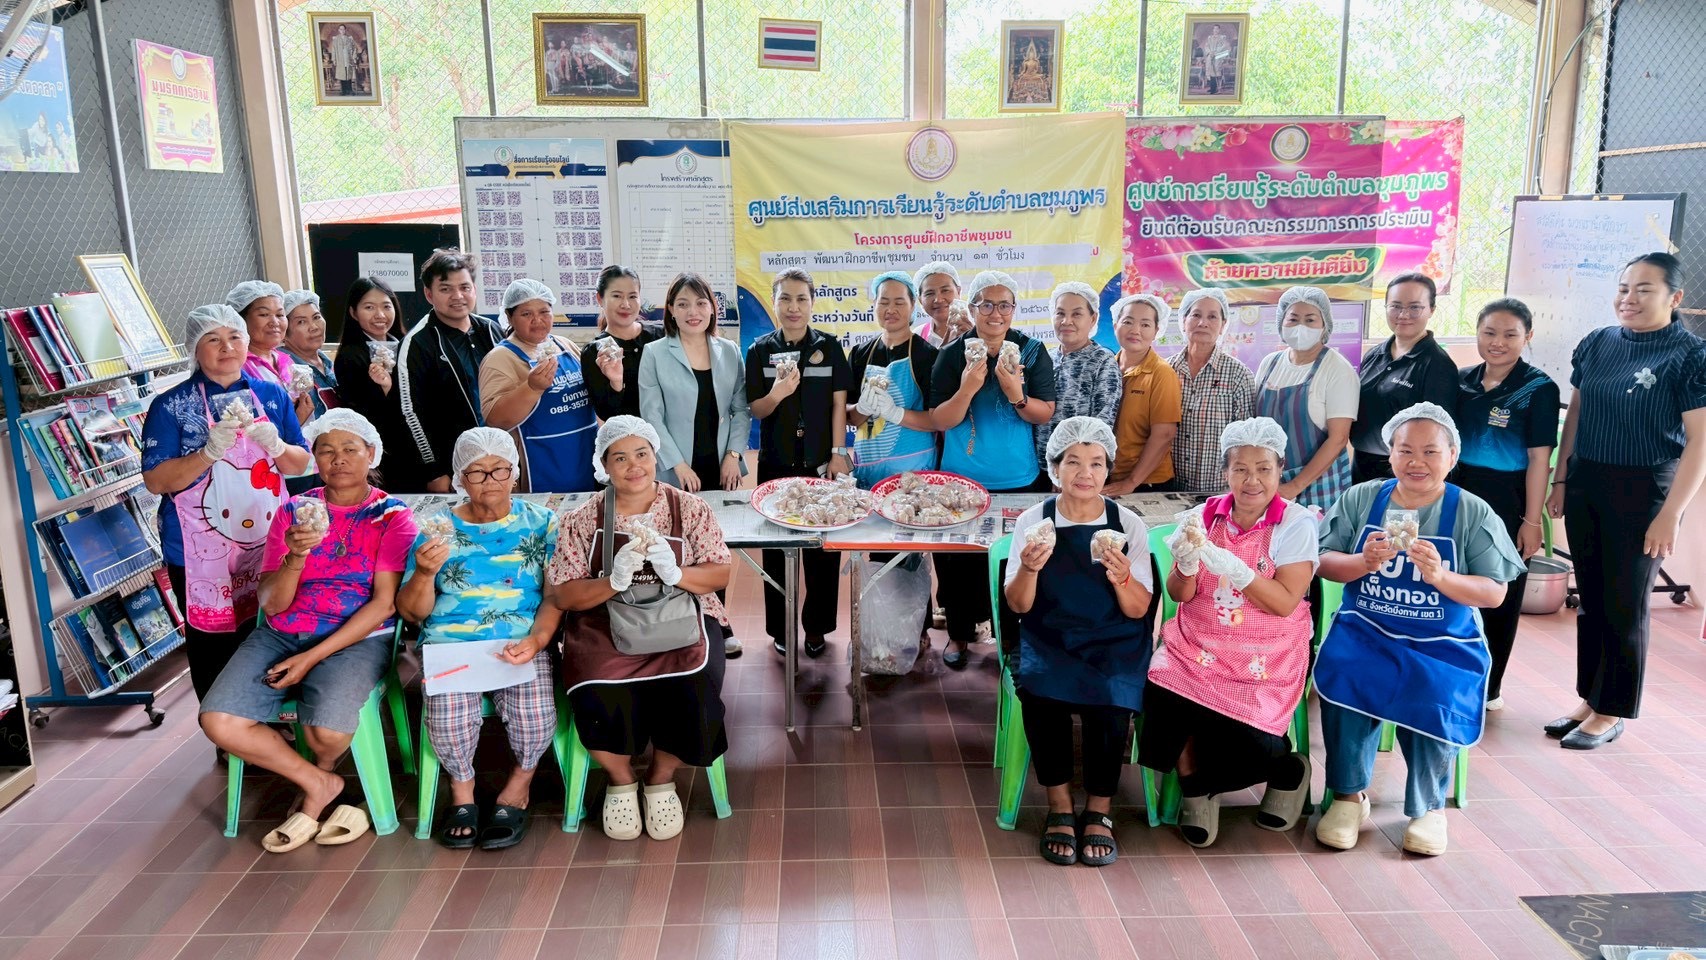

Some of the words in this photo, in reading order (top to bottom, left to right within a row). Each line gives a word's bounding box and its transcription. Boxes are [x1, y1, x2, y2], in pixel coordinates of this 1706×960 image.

[1127, 171, 1449, 210] ศูนย์การเรียนรู้ระดับตำบลชุมภูพร
[748, 187, 1106, 224] ศูนย์ส่งเสริมการเรียนรู้ระดับตำบลชุมภูพร
[1140, 209, 1432, 238] ยินดีต้อนรับคณะกรรมการการประเมิน
[854, 228, 1012, 249] โครงการศูนย์ฝึกอาชีพชุมชน
[767, 253, 807, 267] หลักสูตร
[931, 250, 963, 262] จำนวน
[996, 247, 1025, 261] ชั่วโมง
[1204, 252, 1367, 281] ด้วยความยินดียิ่ง
[812, 306, 875, 323] ระหว่างวันที่
[1360, 575, 1440, 606] เพ็งทอง
[1437, 609, 1442, 618] 1
